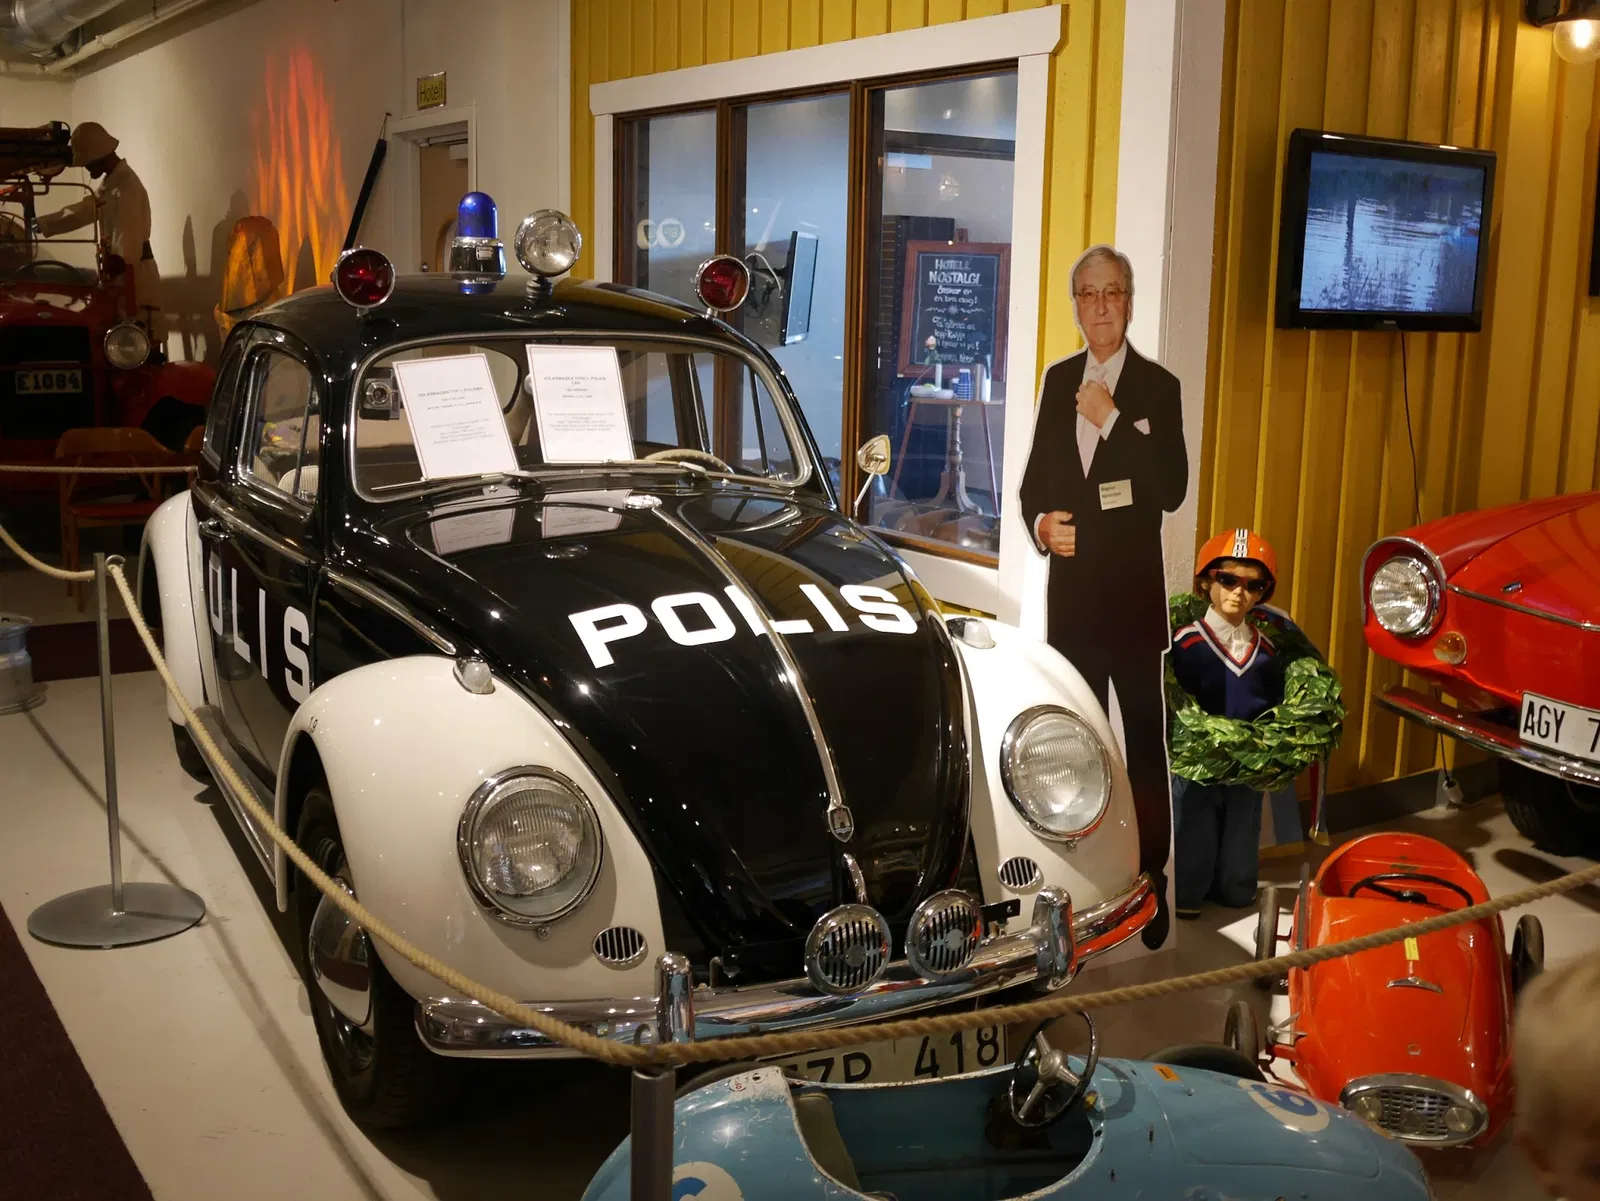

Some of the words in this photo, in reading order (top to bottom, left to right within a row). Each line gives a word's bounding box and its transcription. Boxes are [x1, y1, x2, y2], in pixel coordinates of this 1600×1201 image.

[928, 270, 981, 285] NOSTALGI
[935, 258, 972, 270] HOTELL
[568, 584, 918, 669] POLIS
[1523, 700, 1566, 743] AGY
[783, 1052, 872, 1084] ZP
[914, 1024, 1000, 1078] 418
